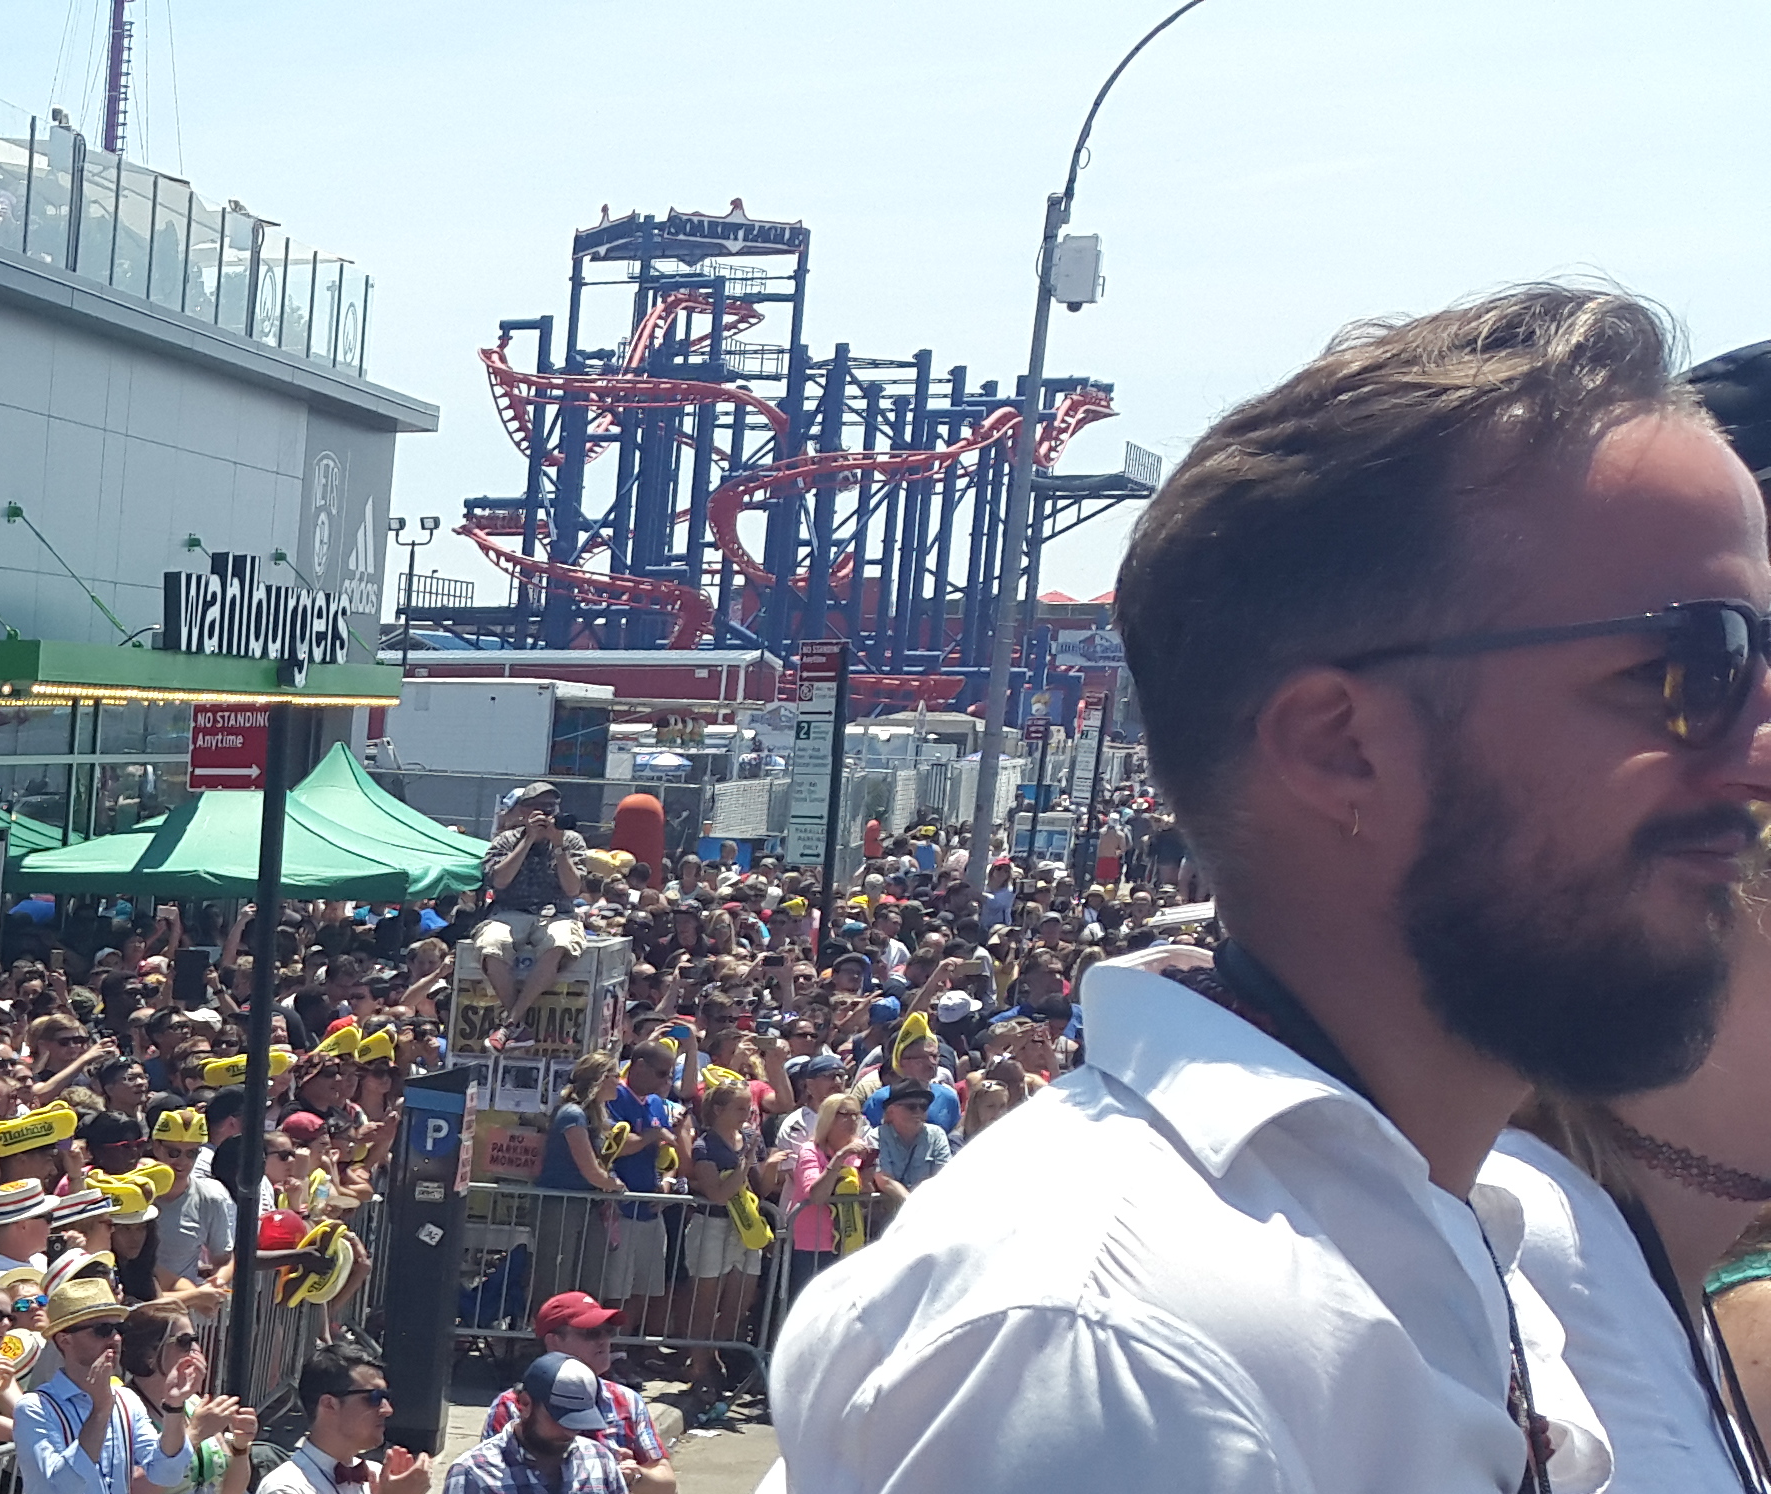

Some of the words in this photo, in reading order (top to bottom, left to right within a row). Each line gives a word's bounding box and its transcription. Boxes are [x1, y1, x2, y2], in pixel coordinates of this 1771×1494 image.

[179, 551, 352, 689] wahlburgers
[197, 711, 213, 728] NO
[196, 731, 244, 749] Anytime
[425, 1118, 449, 1151] P
[490, 1143, 538, 1158] PARKING
[489, 1154, 536, 1168] MONDAY
